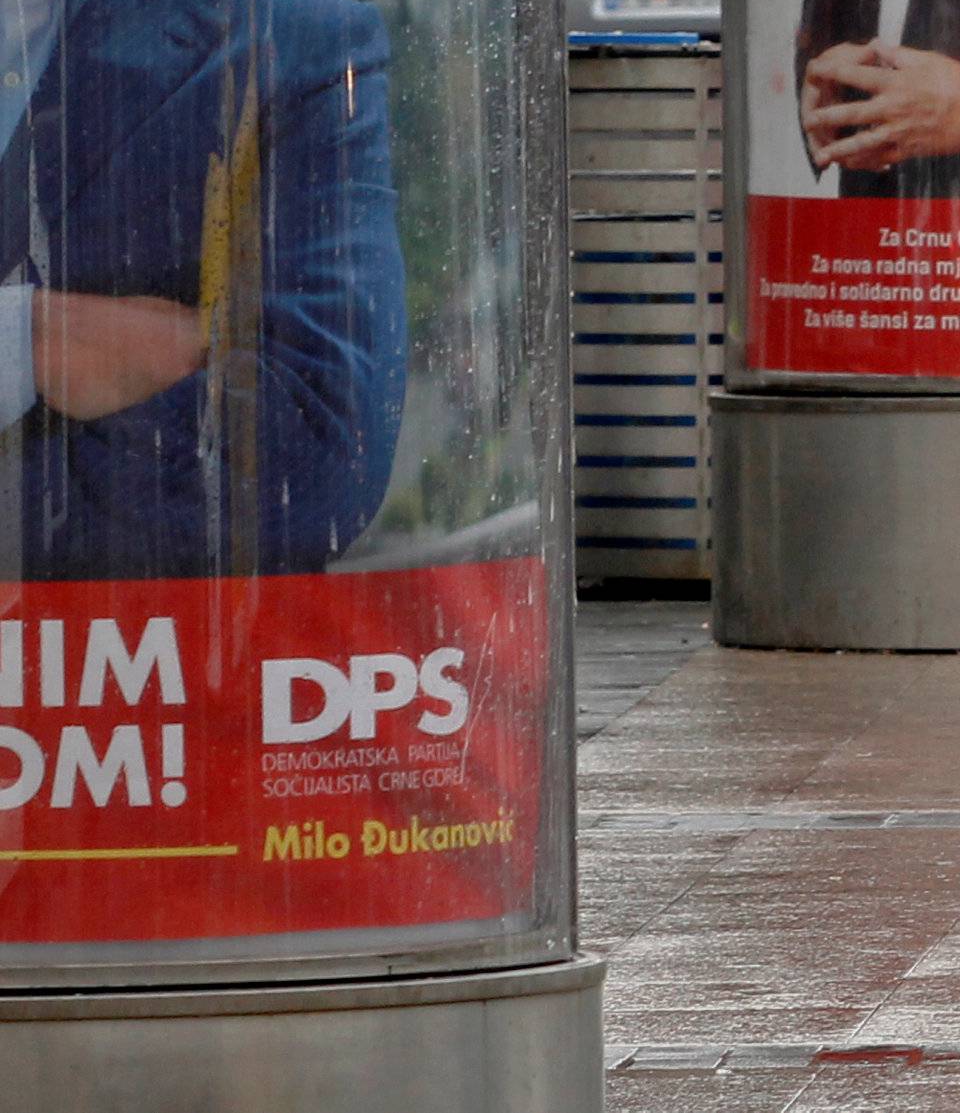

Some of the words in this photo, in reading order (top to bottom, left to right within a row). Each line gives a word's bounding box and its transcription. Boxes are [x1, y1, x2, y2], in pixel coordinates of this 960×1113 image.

[879, 227, 900, 247] Za
[906, 228, 951, 248] Crnu
[811, 254, 829, 274] Za
[833, 261, 871, 275] nova
[876, 257, 930, 275] radna
[839, 284, 924, 302] solidarno
[860, 310, 908, 330] šansi
[913, 315, 935, 330] za
[261, 646, 470, 745] DPS
[262, 747, 399, 772] DEMOKRATSKA
[408, 741, 461, 763] PARTIJA
[378, 770, 421, 792] CRNE
[263, 821, 350, 862] Milo
[361, 807, 514, 857] Đukanović
